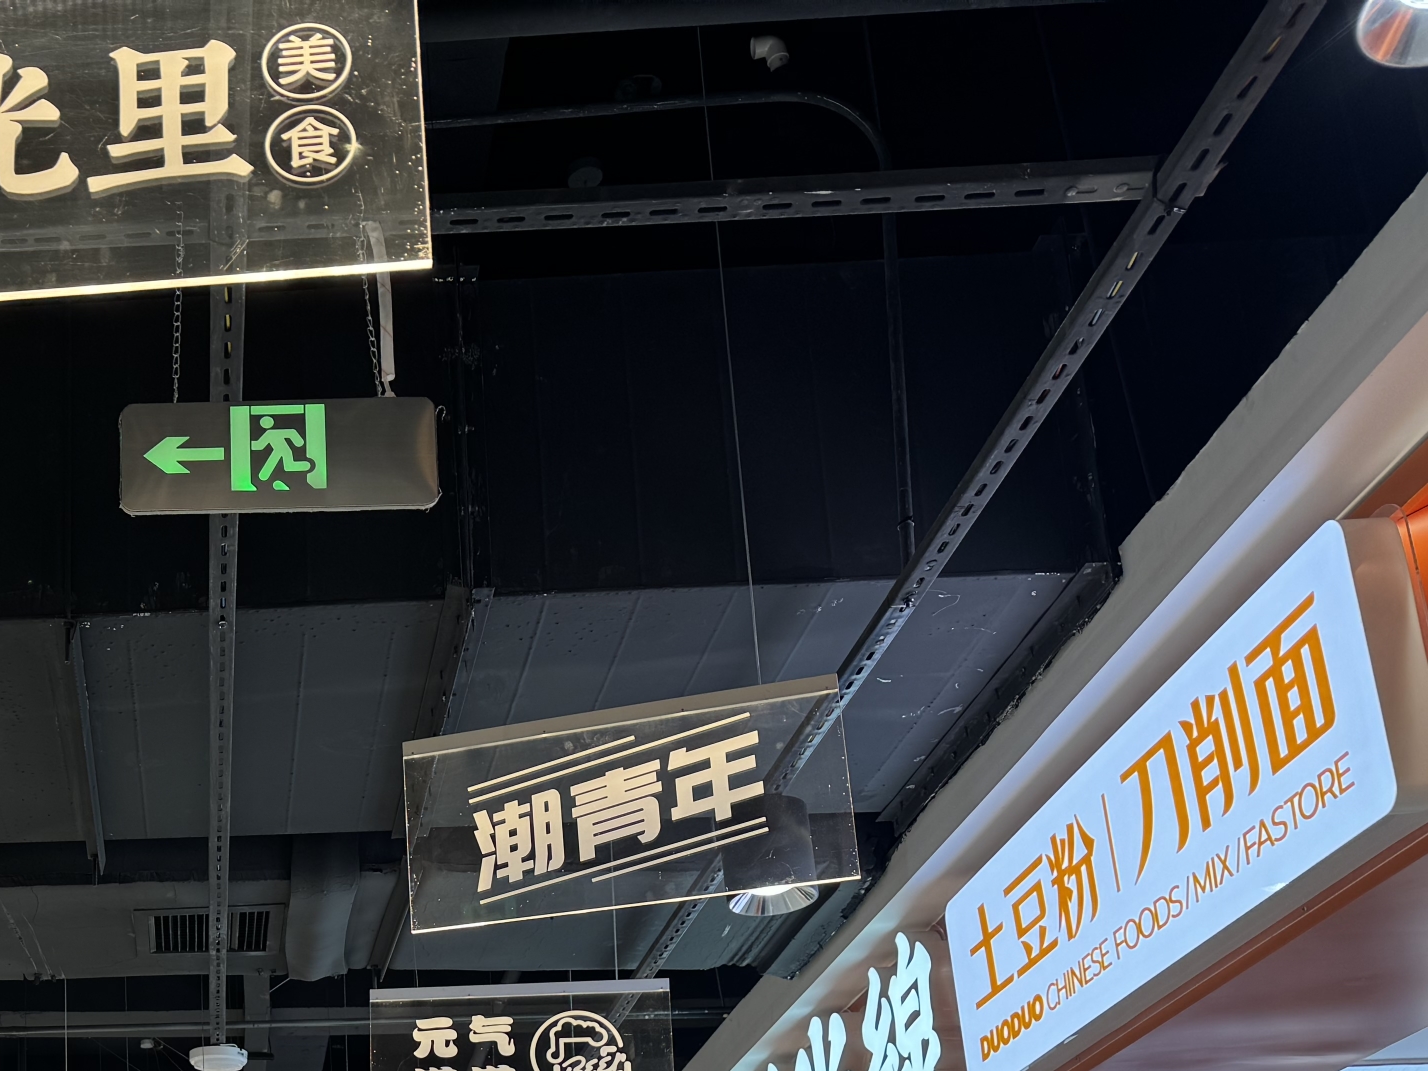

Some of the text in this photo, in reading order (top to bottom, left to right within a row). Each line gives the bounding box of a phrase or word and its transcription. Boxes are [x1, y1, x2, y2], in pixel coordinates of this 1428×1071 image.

[277, 32, 340, 171] 美食
[473, 730, 765, 893] 潮青年
[970, 590, 1336, 1011] 土豆粉 刀削面
[413, 1015, 515, 1058] 元气
[979, 993, 1045, 1062] DUODUO
[1045, 937, 1113, 1012] CHINESE
